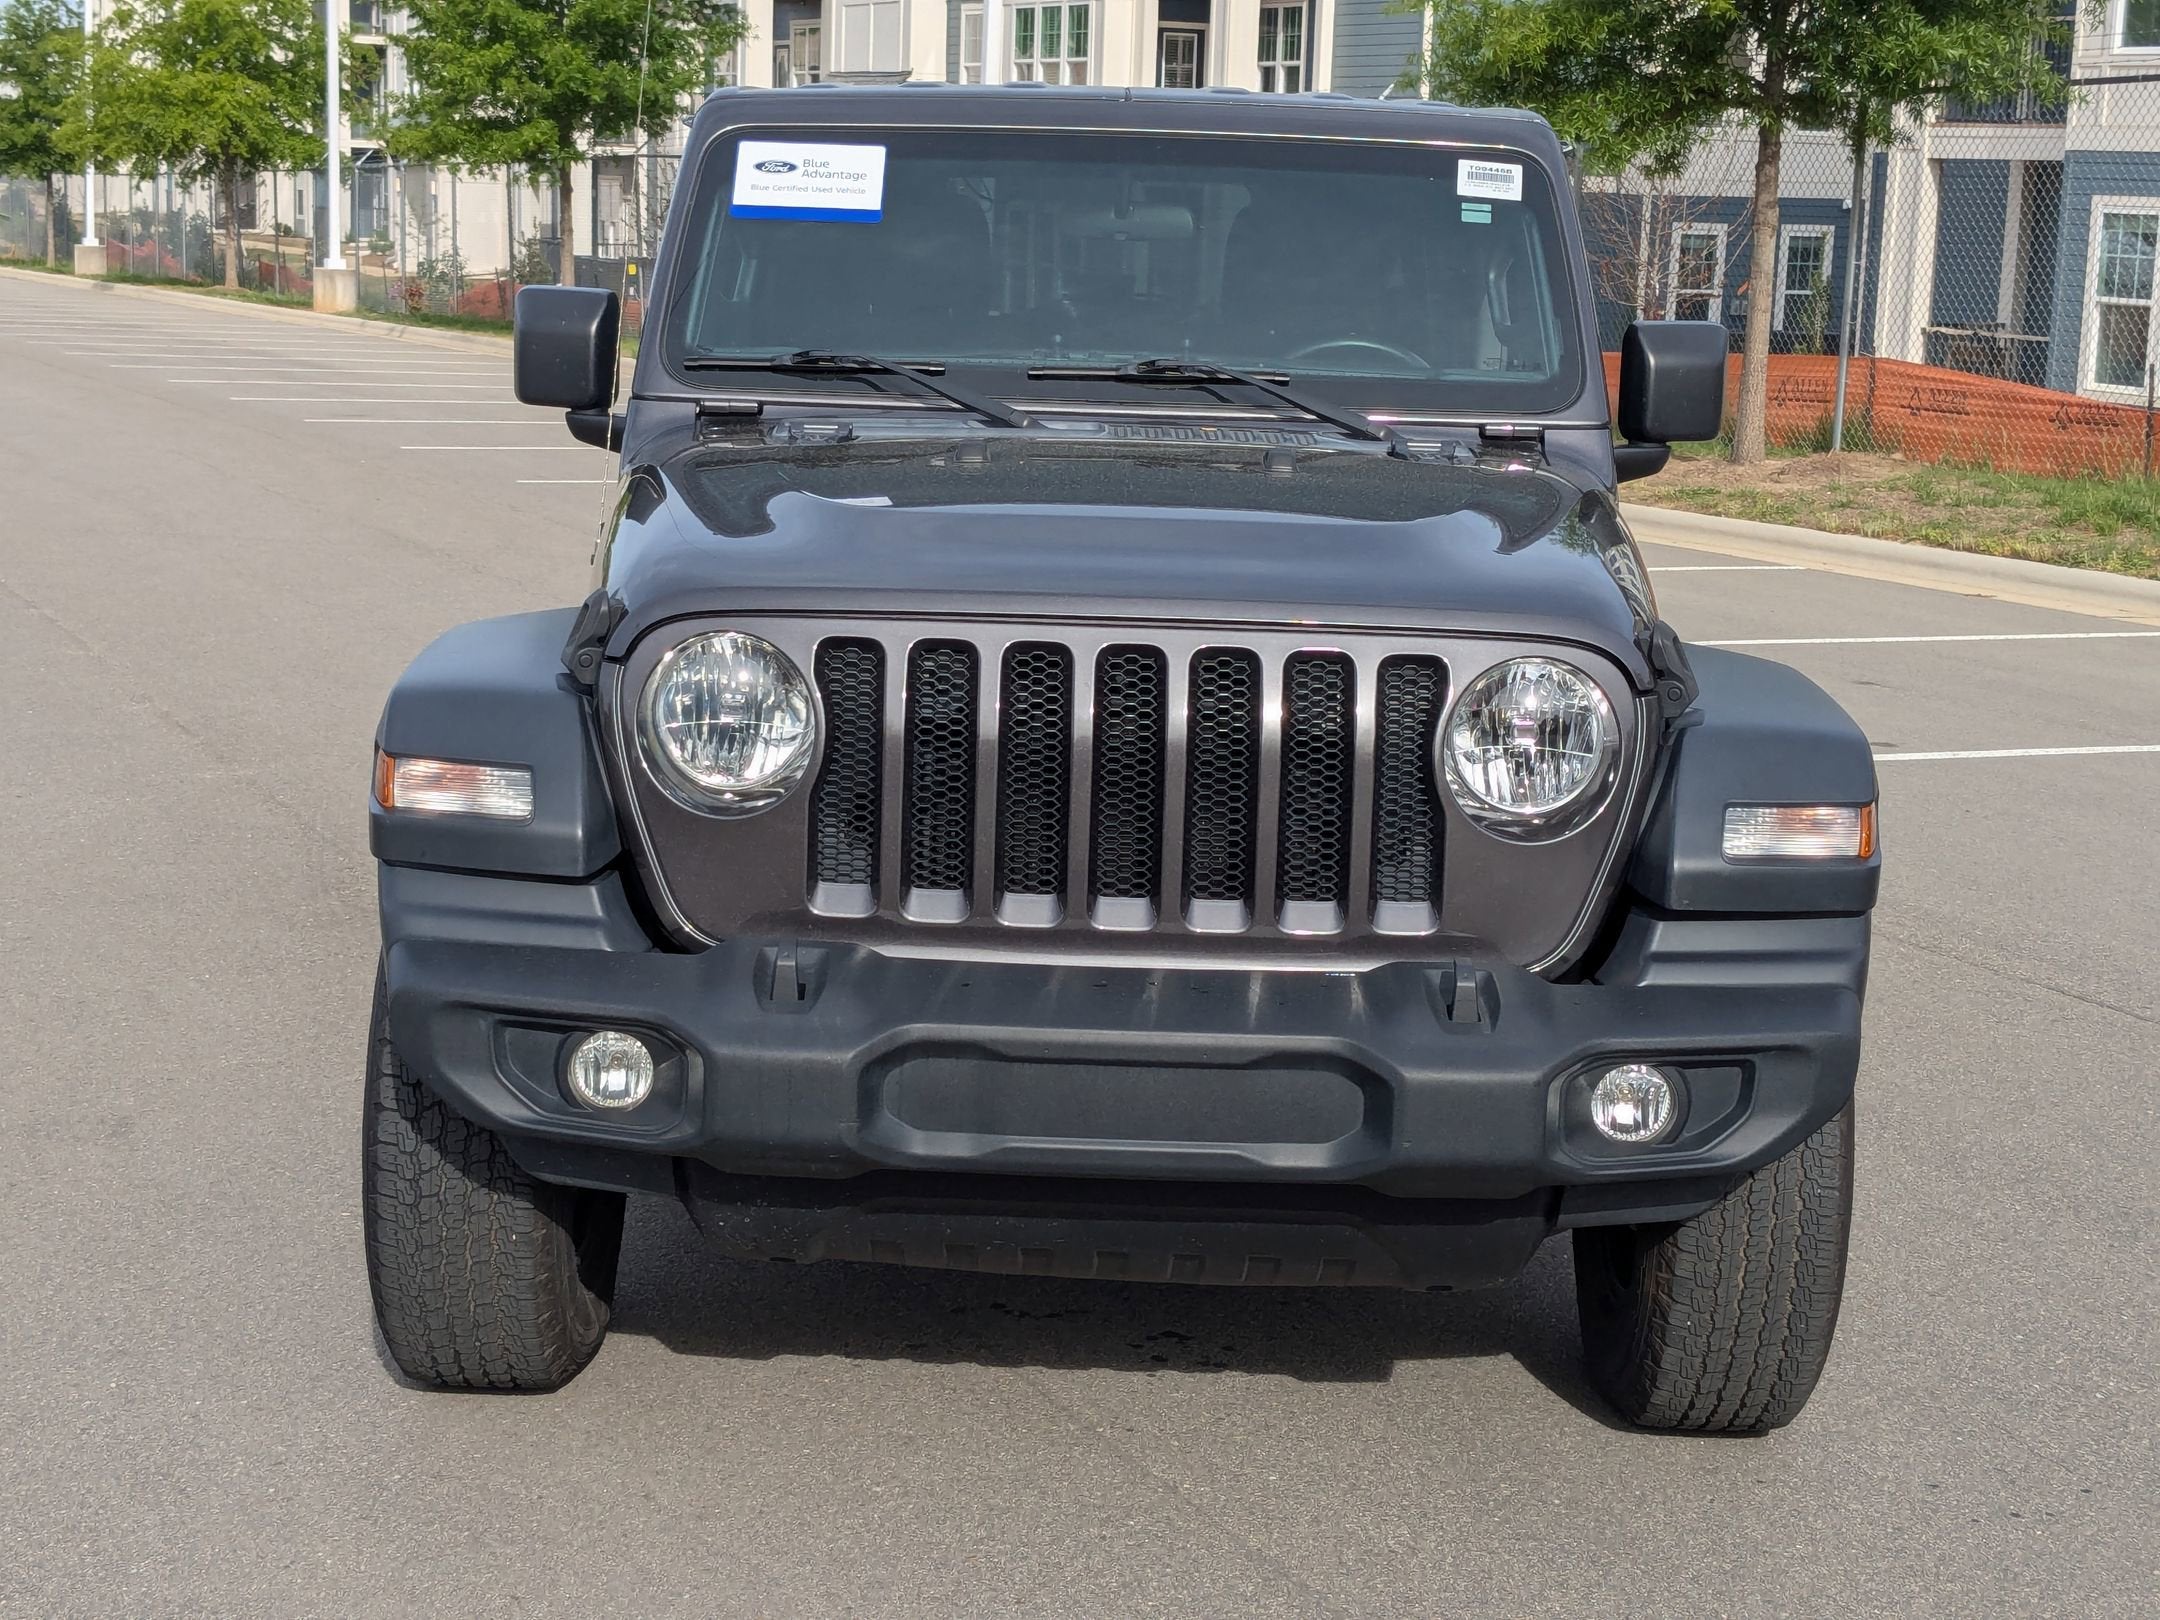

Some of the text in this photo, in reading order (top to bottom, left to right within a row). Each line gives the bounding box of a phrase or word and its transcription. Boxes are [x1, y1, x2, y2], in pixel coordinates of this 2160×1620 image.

[803, 159, 830, 168] Blue
[801, 169, 867, 181] Advantage
[772, 184, 809, 193] Certified
[811, 186, 833, 194] Used
[836, 187, 866, 195] Vehicle
